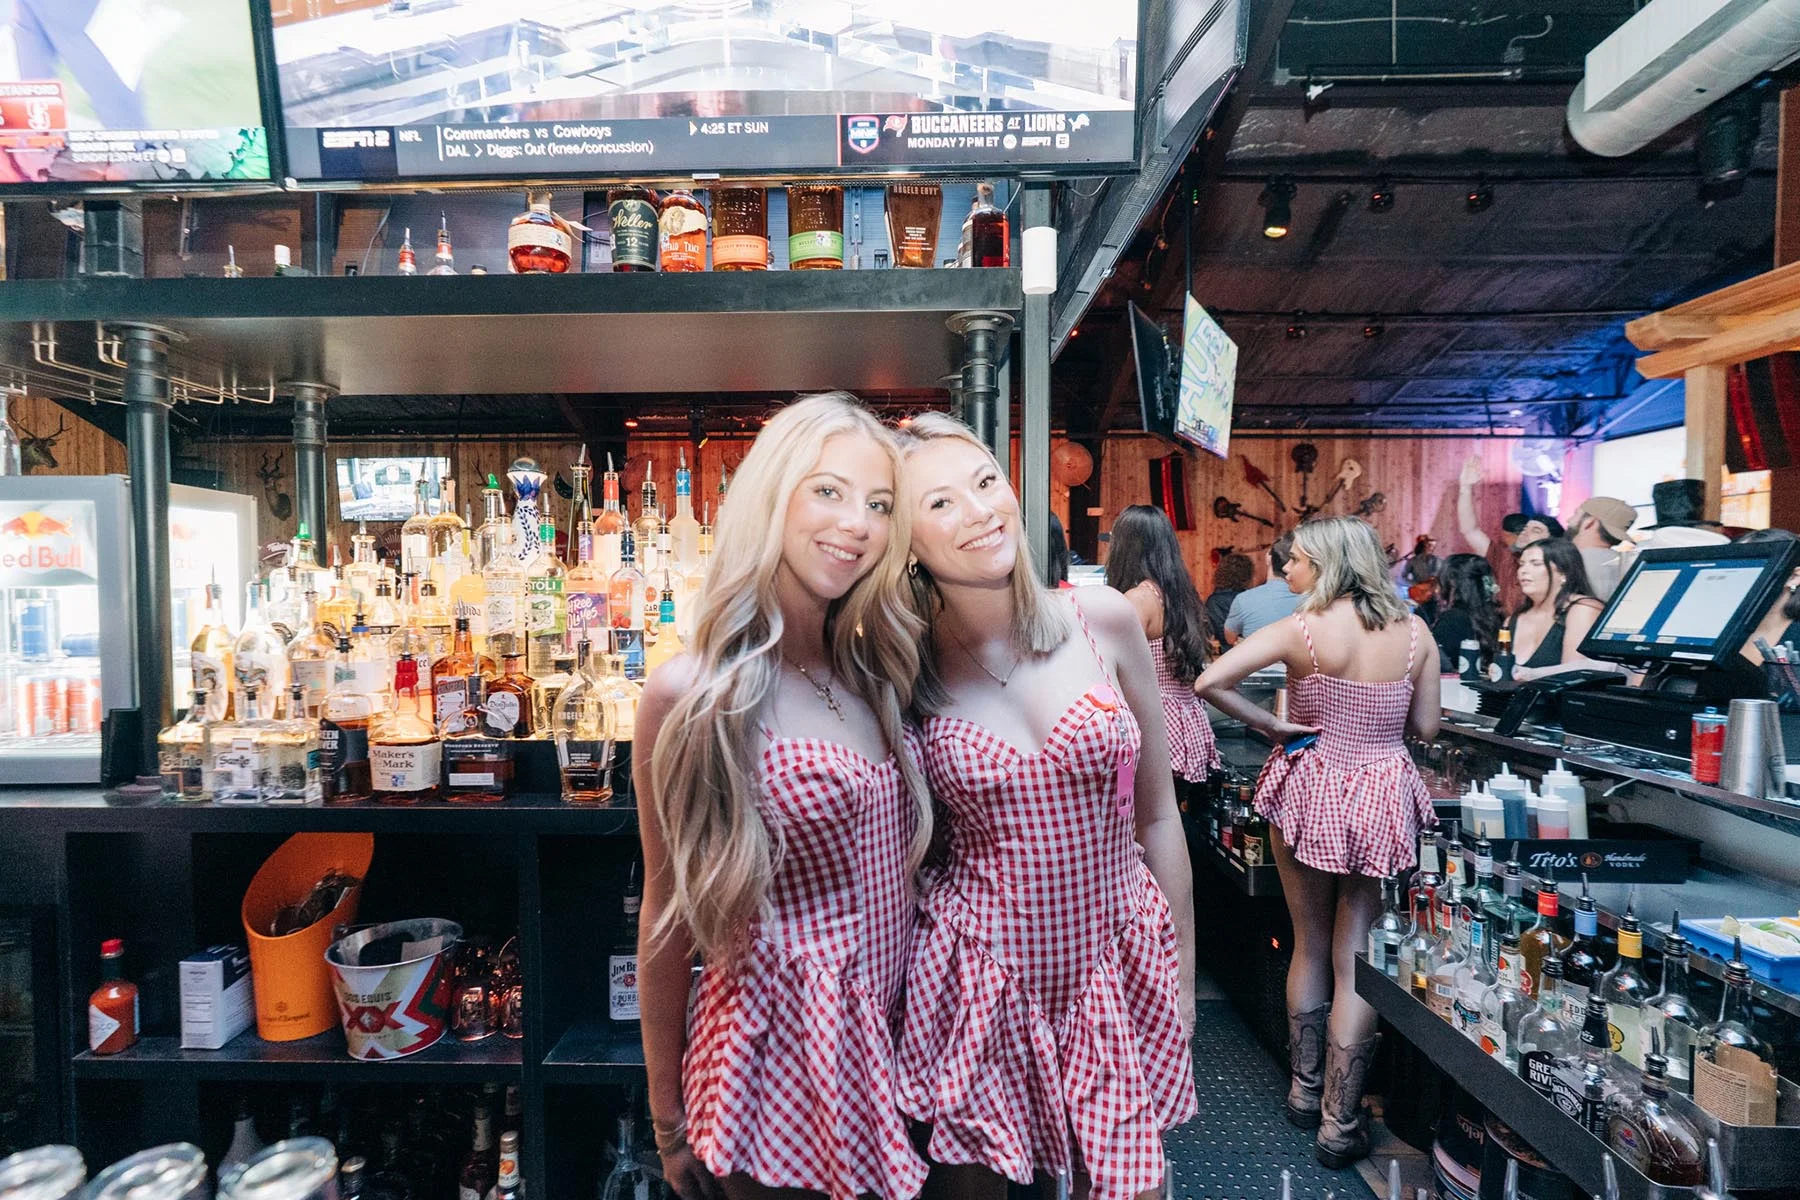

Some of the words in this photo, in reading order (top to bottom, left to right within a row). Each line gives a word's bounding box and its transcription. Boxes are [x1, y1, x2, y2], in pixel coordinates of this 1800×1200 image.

[701, 122, 725, 135] 4:25
[728, 122, 742, 134] ET
[744, 121, 769, 133] SUN
[911, 114, 1003, 133] BUCCANEERS
[1007, 116, 1021, 129] AT
[1024, 114, 1066, 132] LIONS
[323, 130, 390, 148] ESPN2
[443, 126, 530, 141] Commanders
[534, 128, 549, 138] vs
[553, 124, 612, 140] Cowboys
[446, 144, 471, 157] DAL
[487, 143, 522, 159] Diggs:
[524, 143, 546, 156] Out
[547, 140, 655, 157] (knee/concussion)
[907, 136, 957, 148] MONDAY
[959, 136, 965, 148] 7
[966, 136, 985, 147] PM
[986, 136, 1000, 147] ET
[612, 208, 653, 229] Weller
[625, 236, 639, 247] 12
[0, 546, 33, 568] ed
[37, 544, 82, 568] Bull
[219, 755, 251, 768] Santo
[373, 750, 415, 759] Maker's
[382, 760, 415, 769] Mark
[1529, 851, 1578, 868] Tito's
[610, 965, 625, 978] JIM
[626, 961, 637, 973] BE
[360, 990, 393, 1003] EQUIS
[1528, 1058, 1551, 1075] GRE
[1529, 1069, 1552, 1087] RIV
